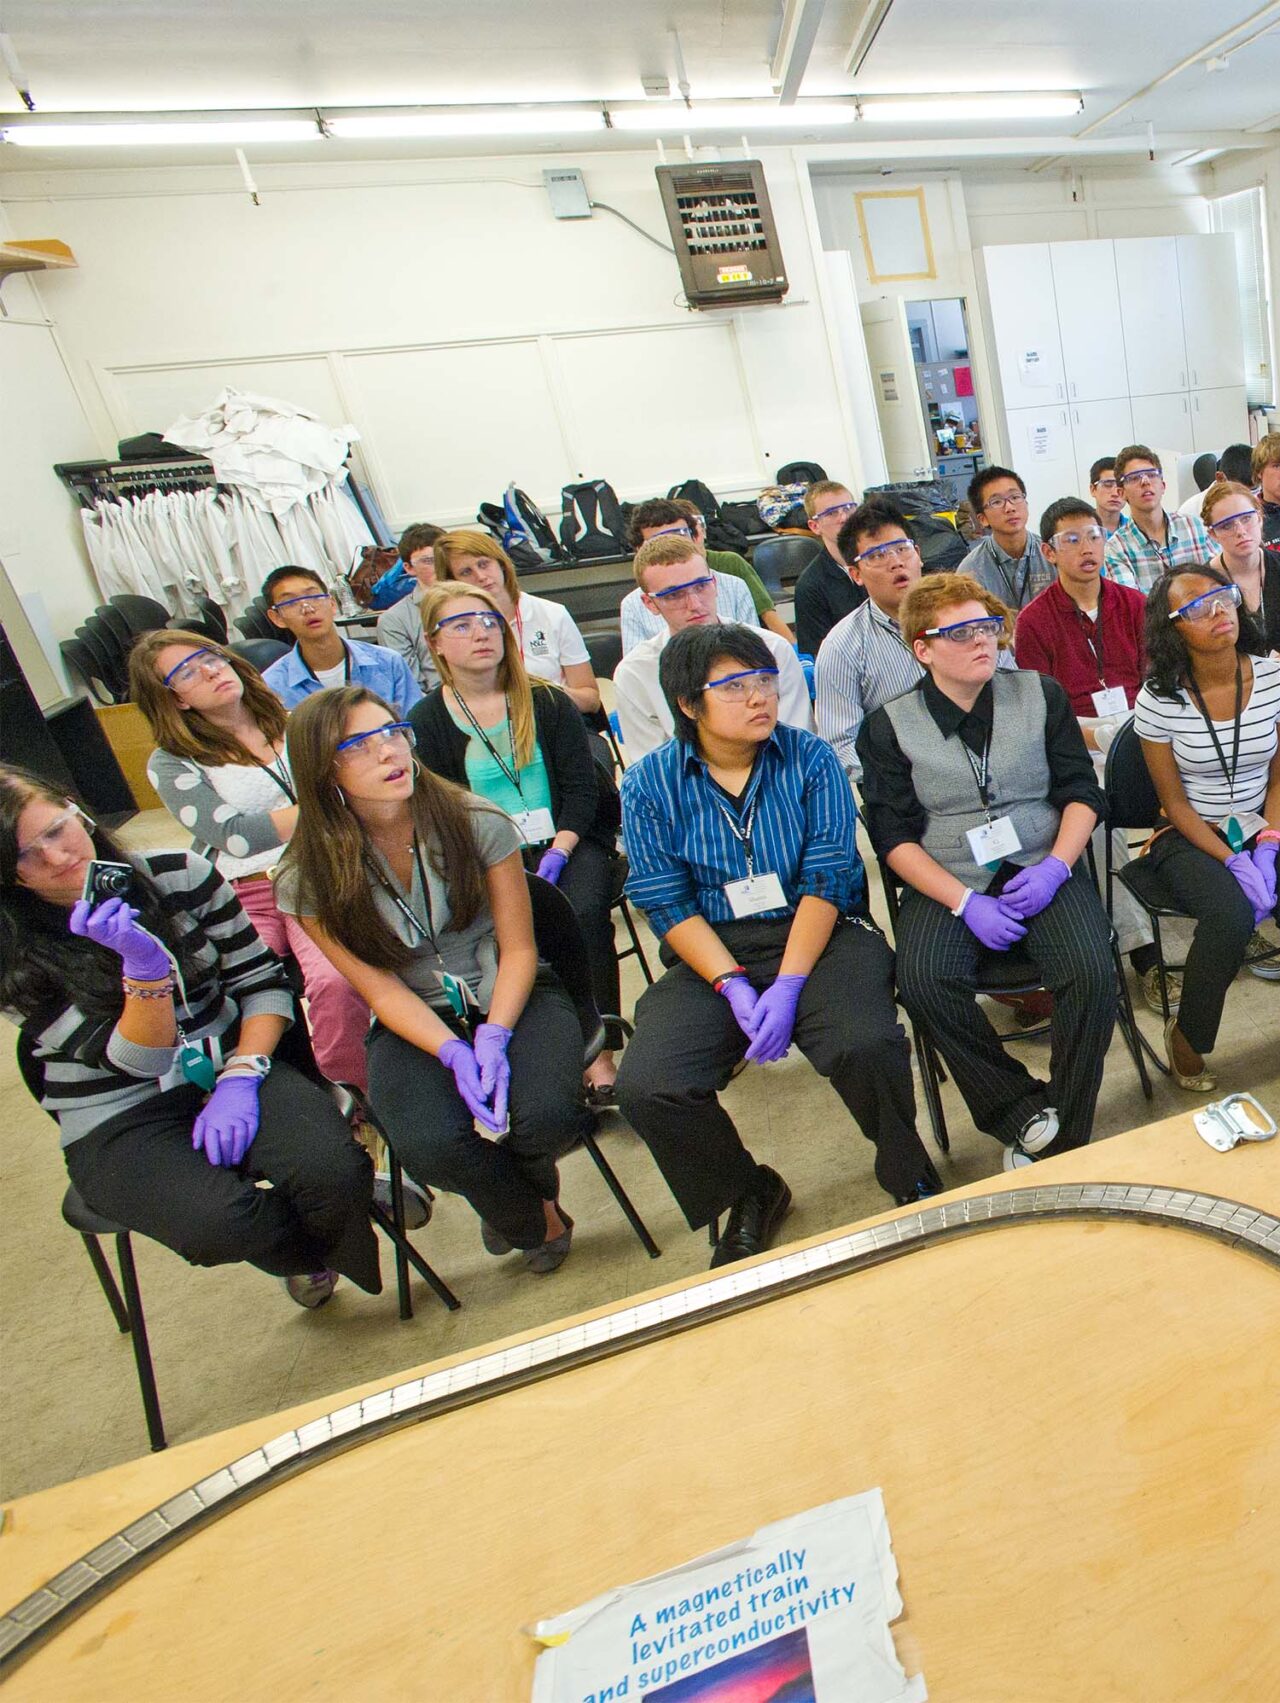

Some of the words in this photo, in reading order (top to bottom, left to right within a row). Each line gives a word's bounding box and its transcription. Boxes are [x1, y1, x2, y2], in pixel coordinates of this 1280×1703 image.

[629, 1614, 647, 1638] A
[656, 1550, 807, 1625] magnetically
[631, 1601, 741, 1665] levitated
[747, 1576, 809, 1613] train
[637, 1583, 856, 1689] superconductivity
